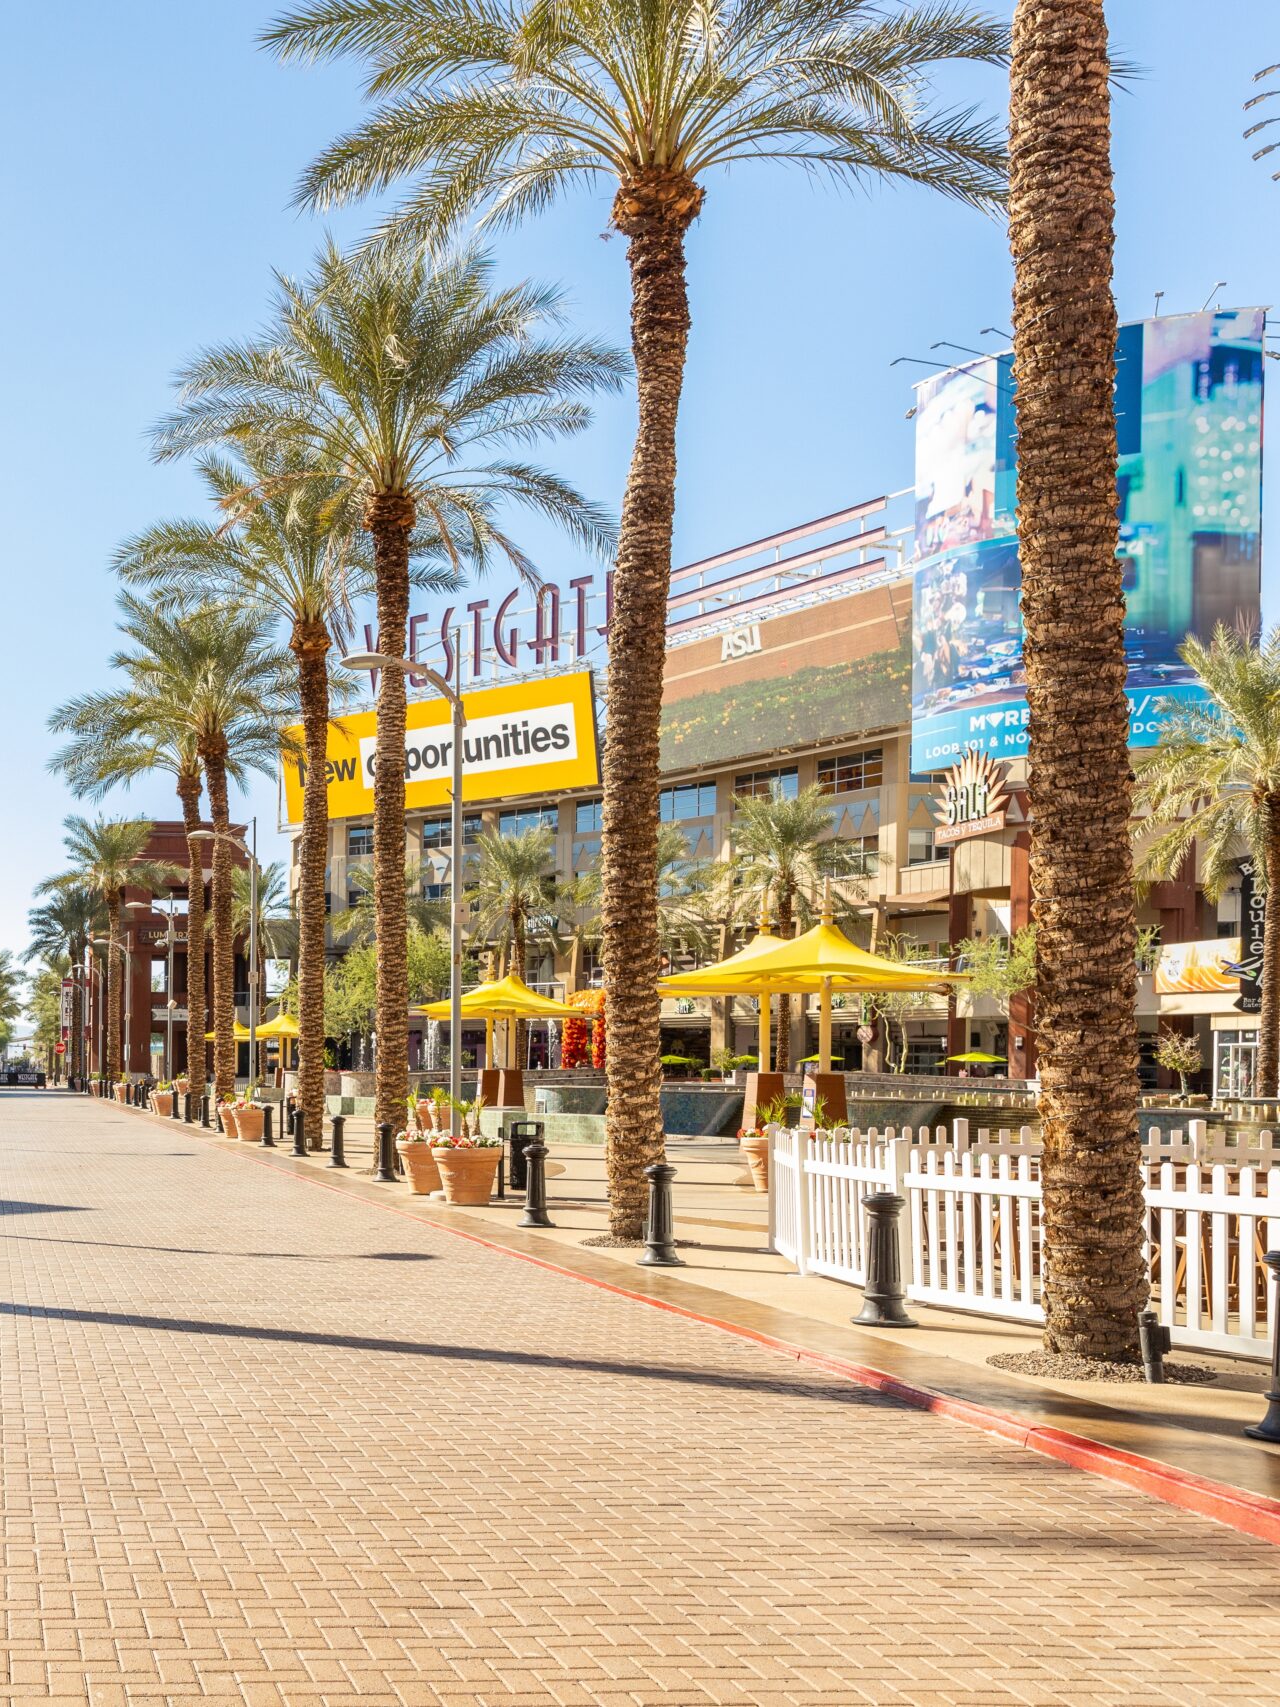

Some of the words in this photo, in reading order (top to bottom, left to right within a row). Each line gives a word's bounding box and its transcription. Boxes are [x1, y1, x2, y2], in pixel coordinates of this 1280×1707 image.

[720, 624, 762, 662] ASU
[963, 738, 984, 751] 101
[989, 736, 998, 748] &
[937, 826, 960, 840] TACOS
[968, 817, 1002, 833] TEQUILA
